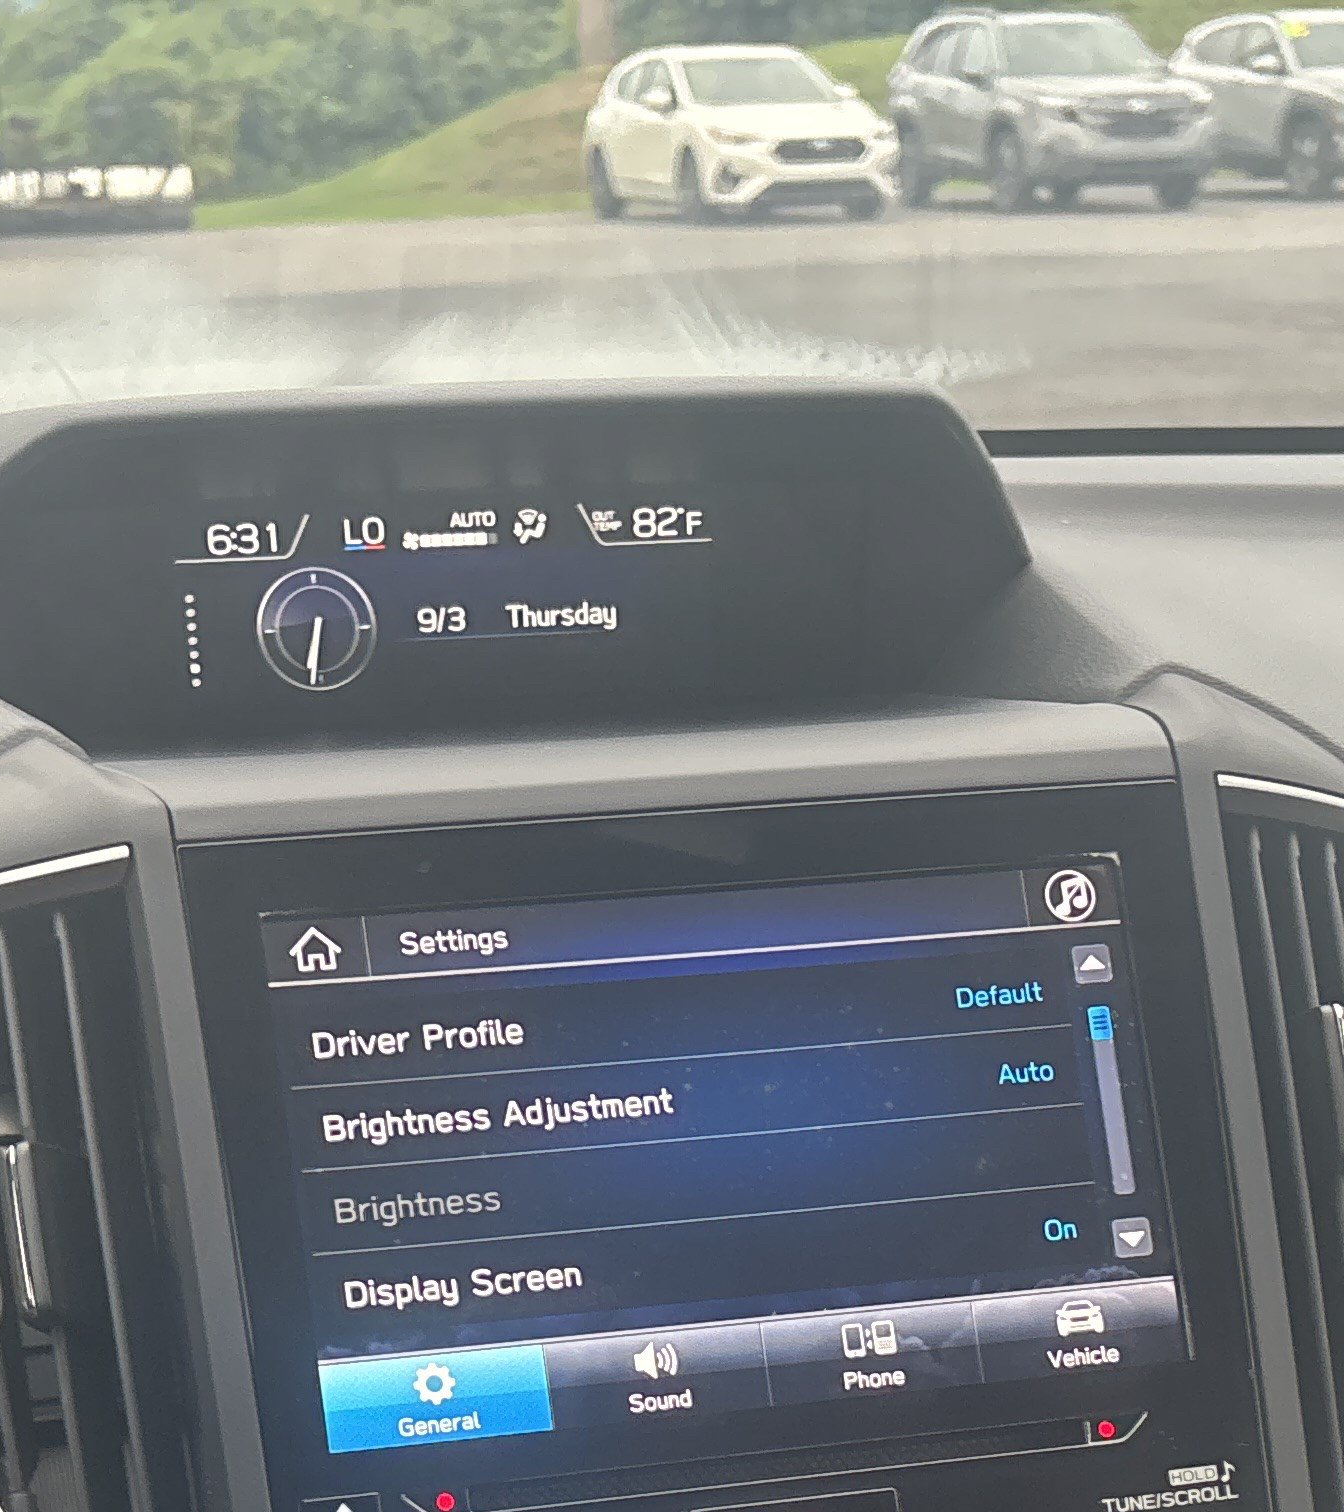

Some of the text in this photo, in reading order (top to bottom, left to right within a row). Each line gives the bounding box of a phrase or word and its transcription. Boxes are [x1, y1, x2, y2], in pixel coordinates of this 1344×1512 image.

[343, 516, 386, 545] LO
[449, 509, 497, 528] AUTO
[207, 521, 279, 556] 6:31
[417, 601, 618, 634] 9/3 Thursday
[399, 928, 509, 956] Settings
[955, 981, 1044, 1010] Default
[311, 1018, 525, 1060] Driver Profile
[998, 1060, 1055, 1085] Auto
[322, 1087, 674, 1146] Brightness Adjustment
[333, 1190, 502, 1227] Brightness
[1043, 1218, 1079, 1242] On
[343, 1265, 584, 1311] Display Screen
[1046, 1345, 1121, 1370] Vehicle
[842, 1369, 906, 1391] Phone
[628, 1388, 693, 1414] Sound
[397, 1411, 482, 1438] General
[1170, 1466, 1217, 1485] HOLD
